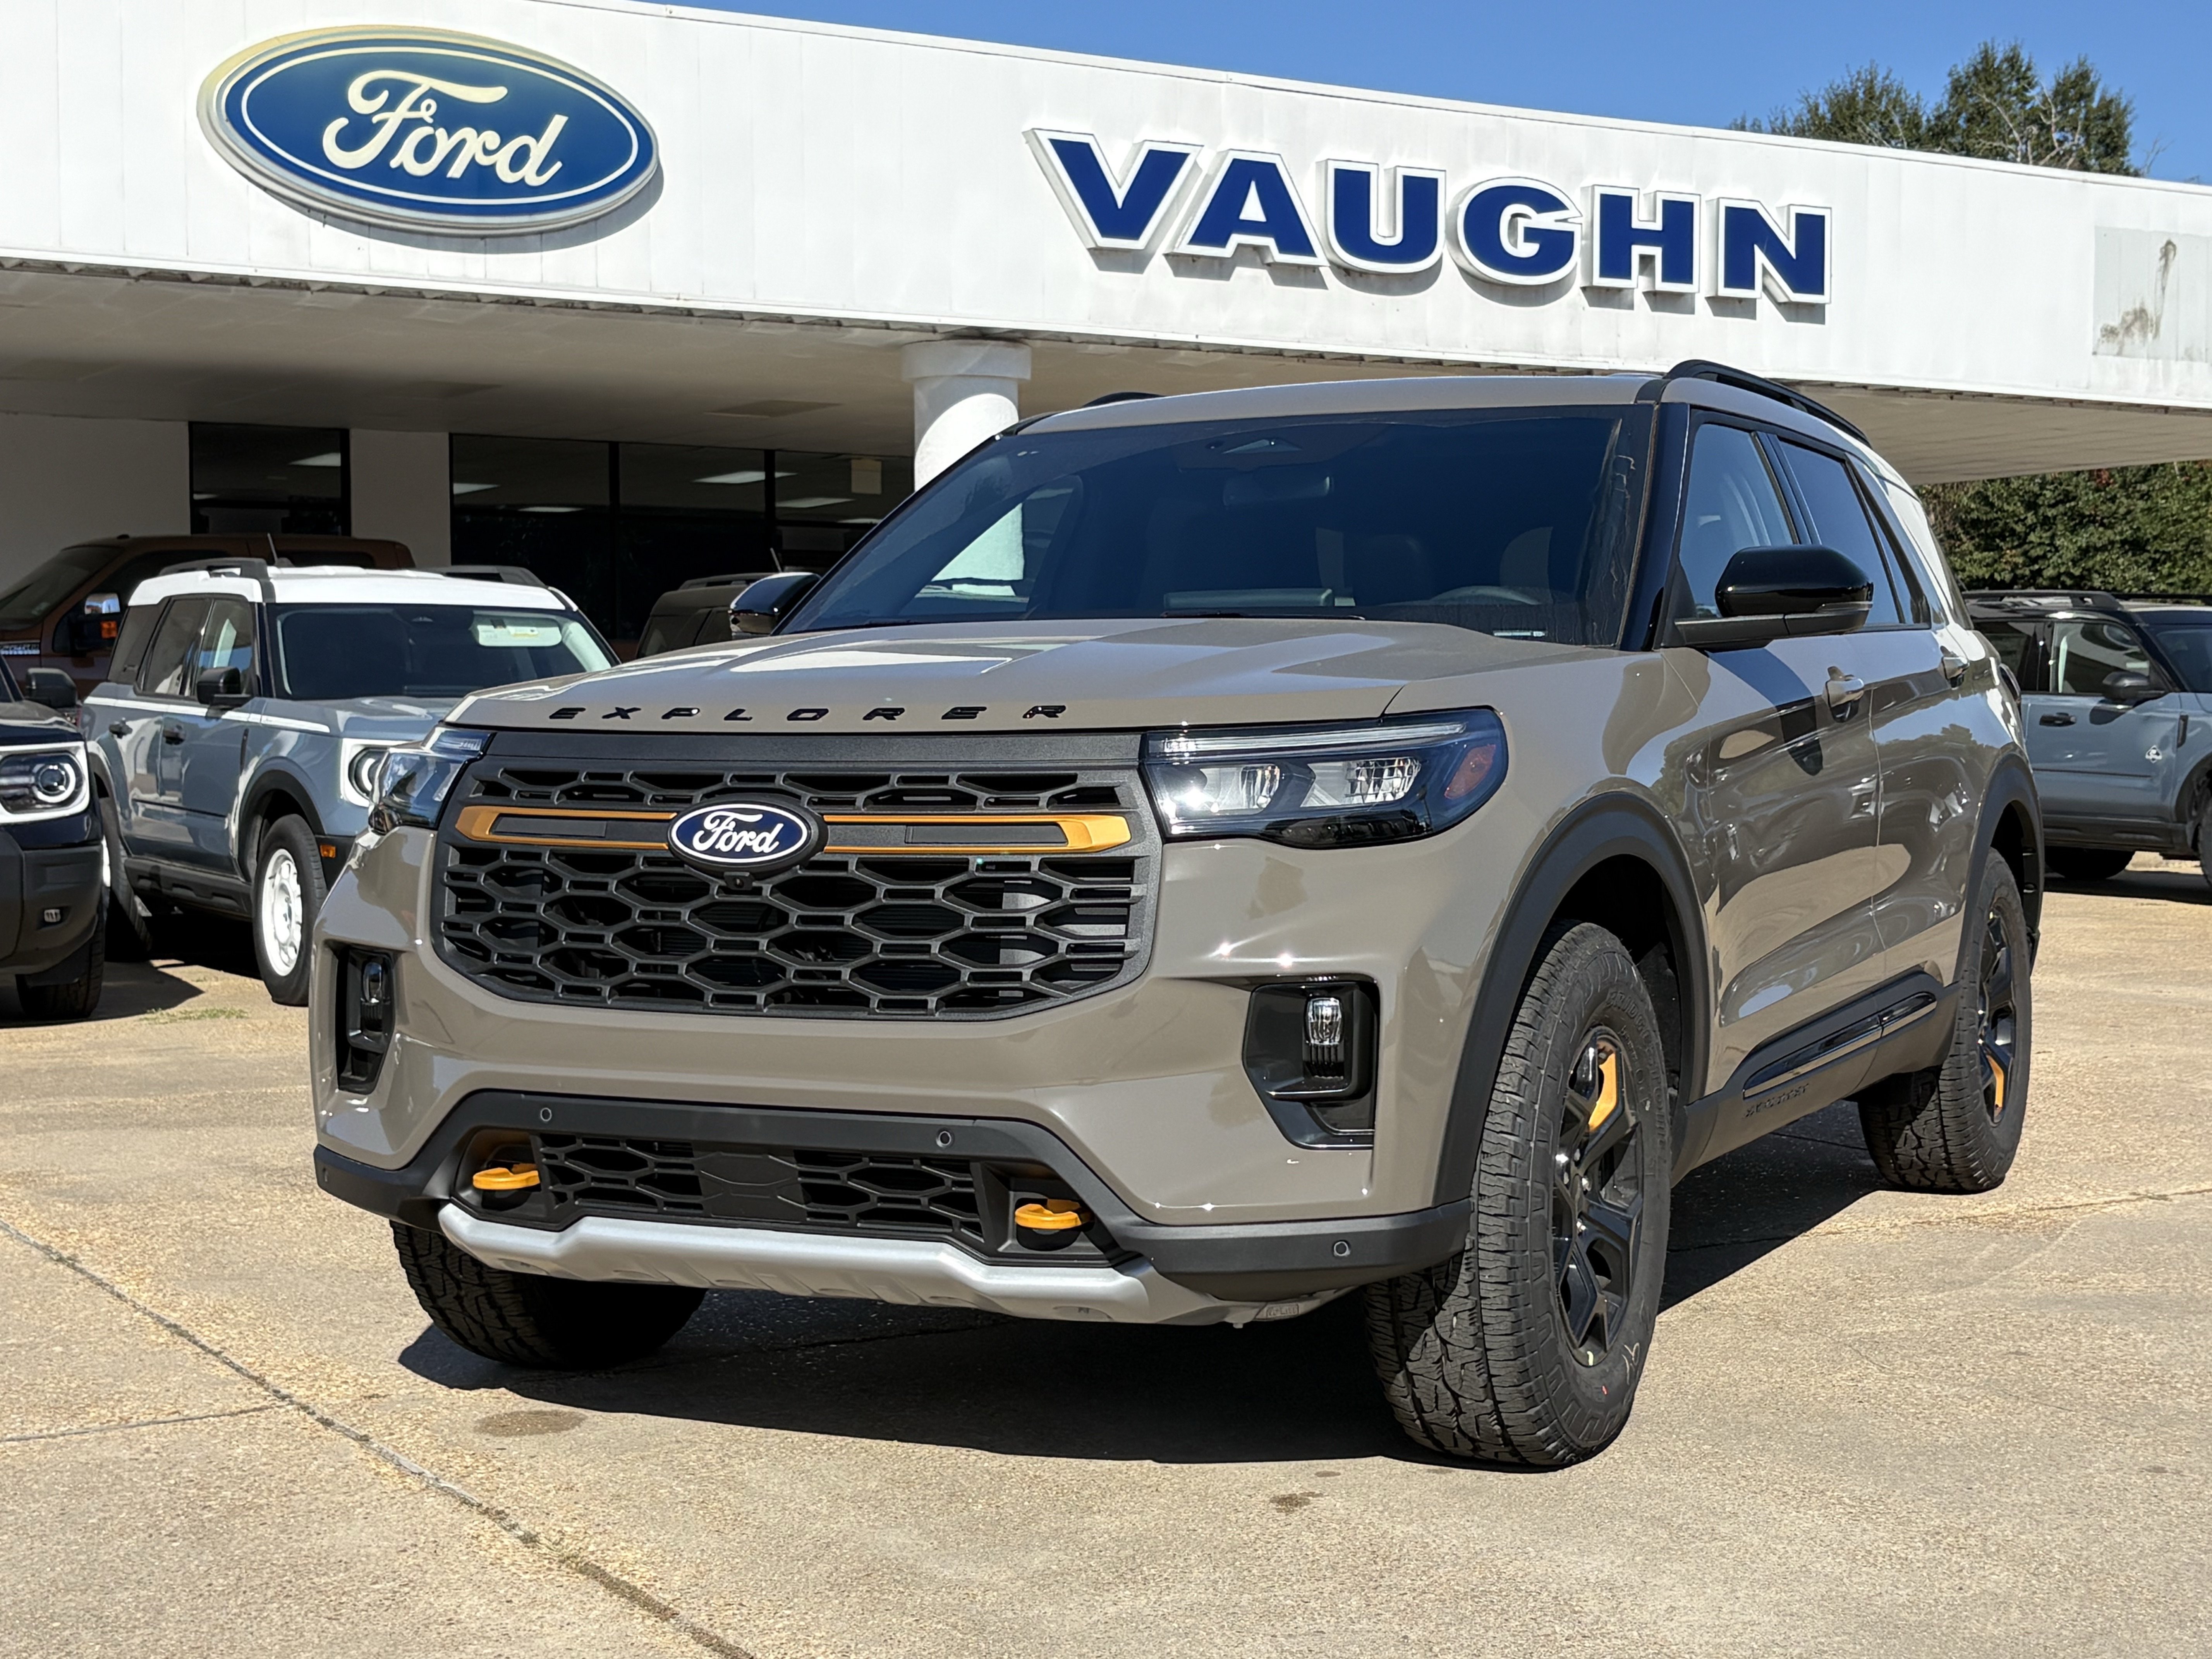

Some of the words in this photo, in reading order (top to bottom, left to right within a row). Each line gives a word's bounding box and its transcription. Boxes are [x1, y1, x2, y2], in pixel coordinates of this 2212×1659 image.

[322, 70, 568, 186] Ford
[1032, 132, 1830, 302] VAUGHN
[548, 705, 1066, 721] EXPLORER
[692, 811, 784, 854] Ford
